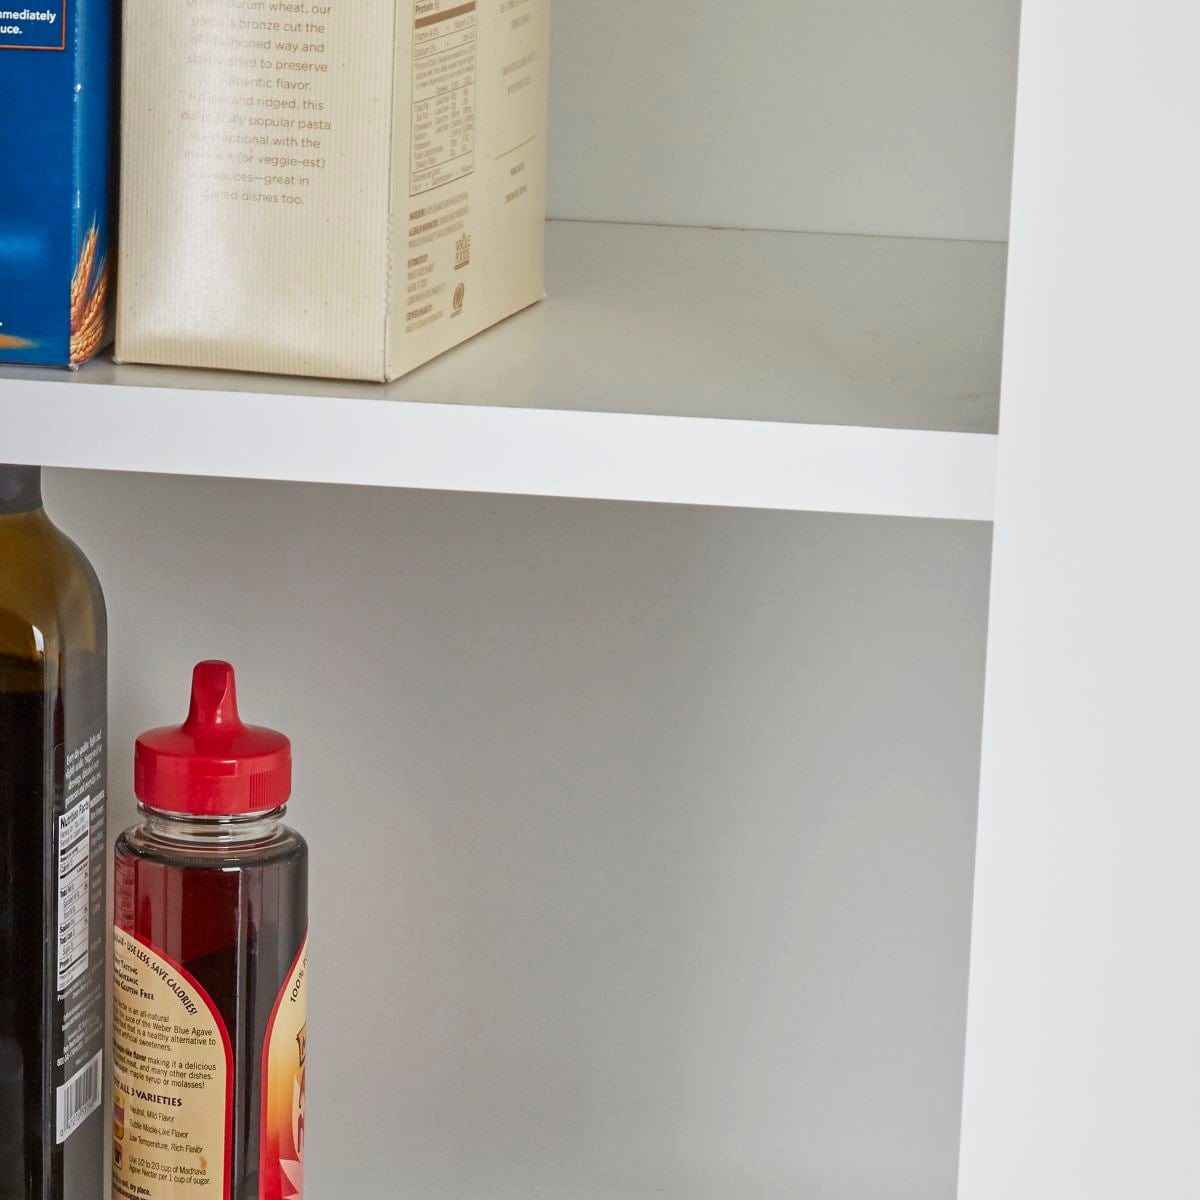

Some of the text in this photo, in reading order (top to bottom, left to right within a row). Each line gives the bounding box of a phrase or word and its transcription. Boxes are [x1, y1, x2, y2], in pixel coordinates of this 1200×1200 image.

[269, 2, 331, 14] wheat, our
[275, 42, 325, 52] way and
[276, 61, 328, 72] preserve
[249, 116, 331, 130] popular pasta
[127, 941, 136, 955] USE
[136, 950, 150, 967] LESS,
[151, 962, 168, 980] SAVE
[167, 978, 198, 1015] CALORIES!
[174, 1026, 212, 1036] Blue Agave
[135, 1090, 182, 1106] VARIETIES
